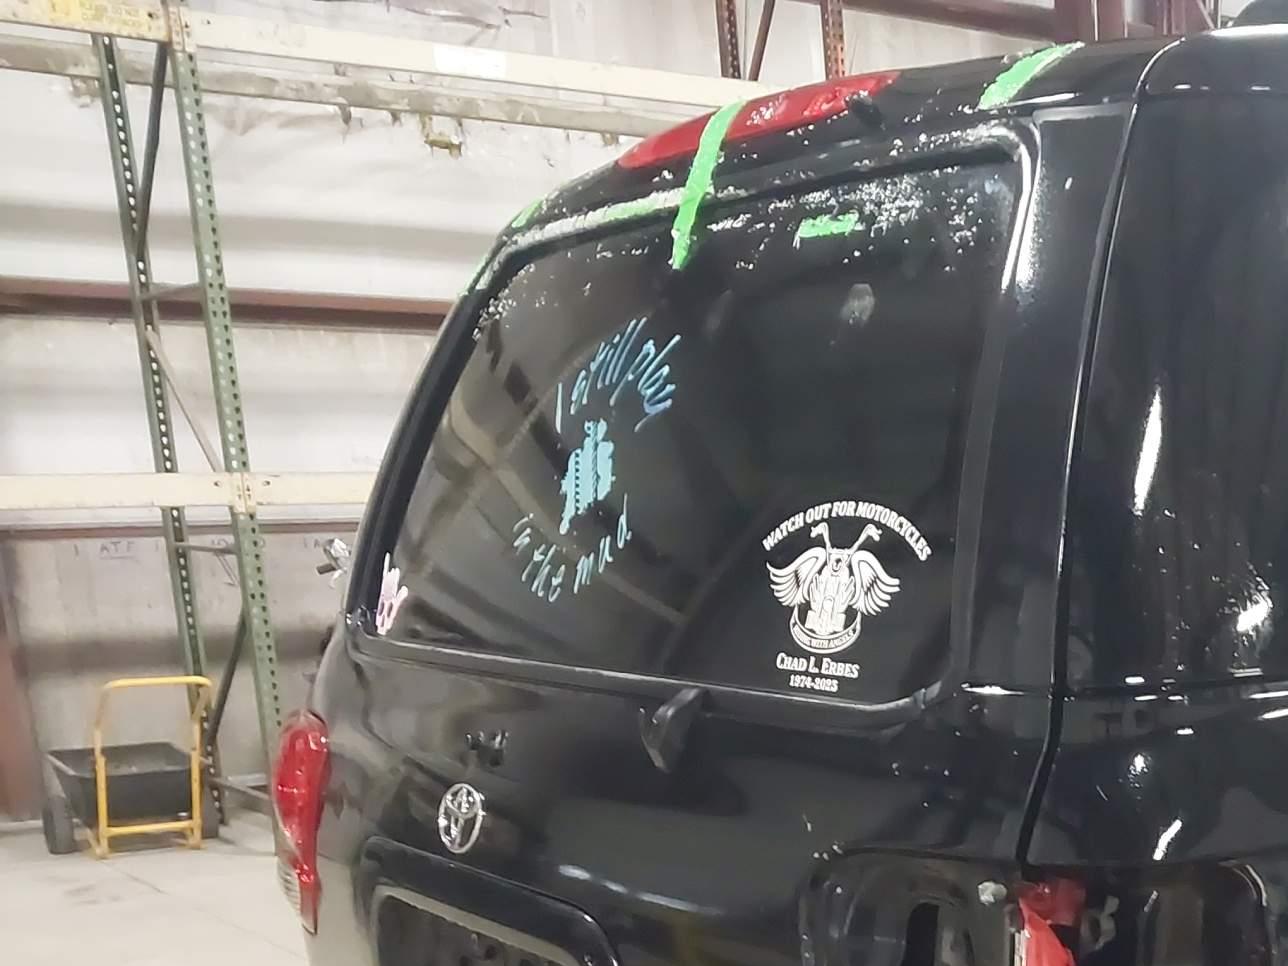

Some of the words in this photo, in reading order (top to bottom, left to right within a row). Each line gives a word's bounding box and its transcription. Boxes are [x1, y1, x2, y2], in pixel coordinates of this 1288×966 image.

[761, 513, 804, 551] WATCH
[805, 503, 832, 523] OUT
[832, 500, 856, 518] FOR
[858, 501, 932, 561] MOTORCYCLES
